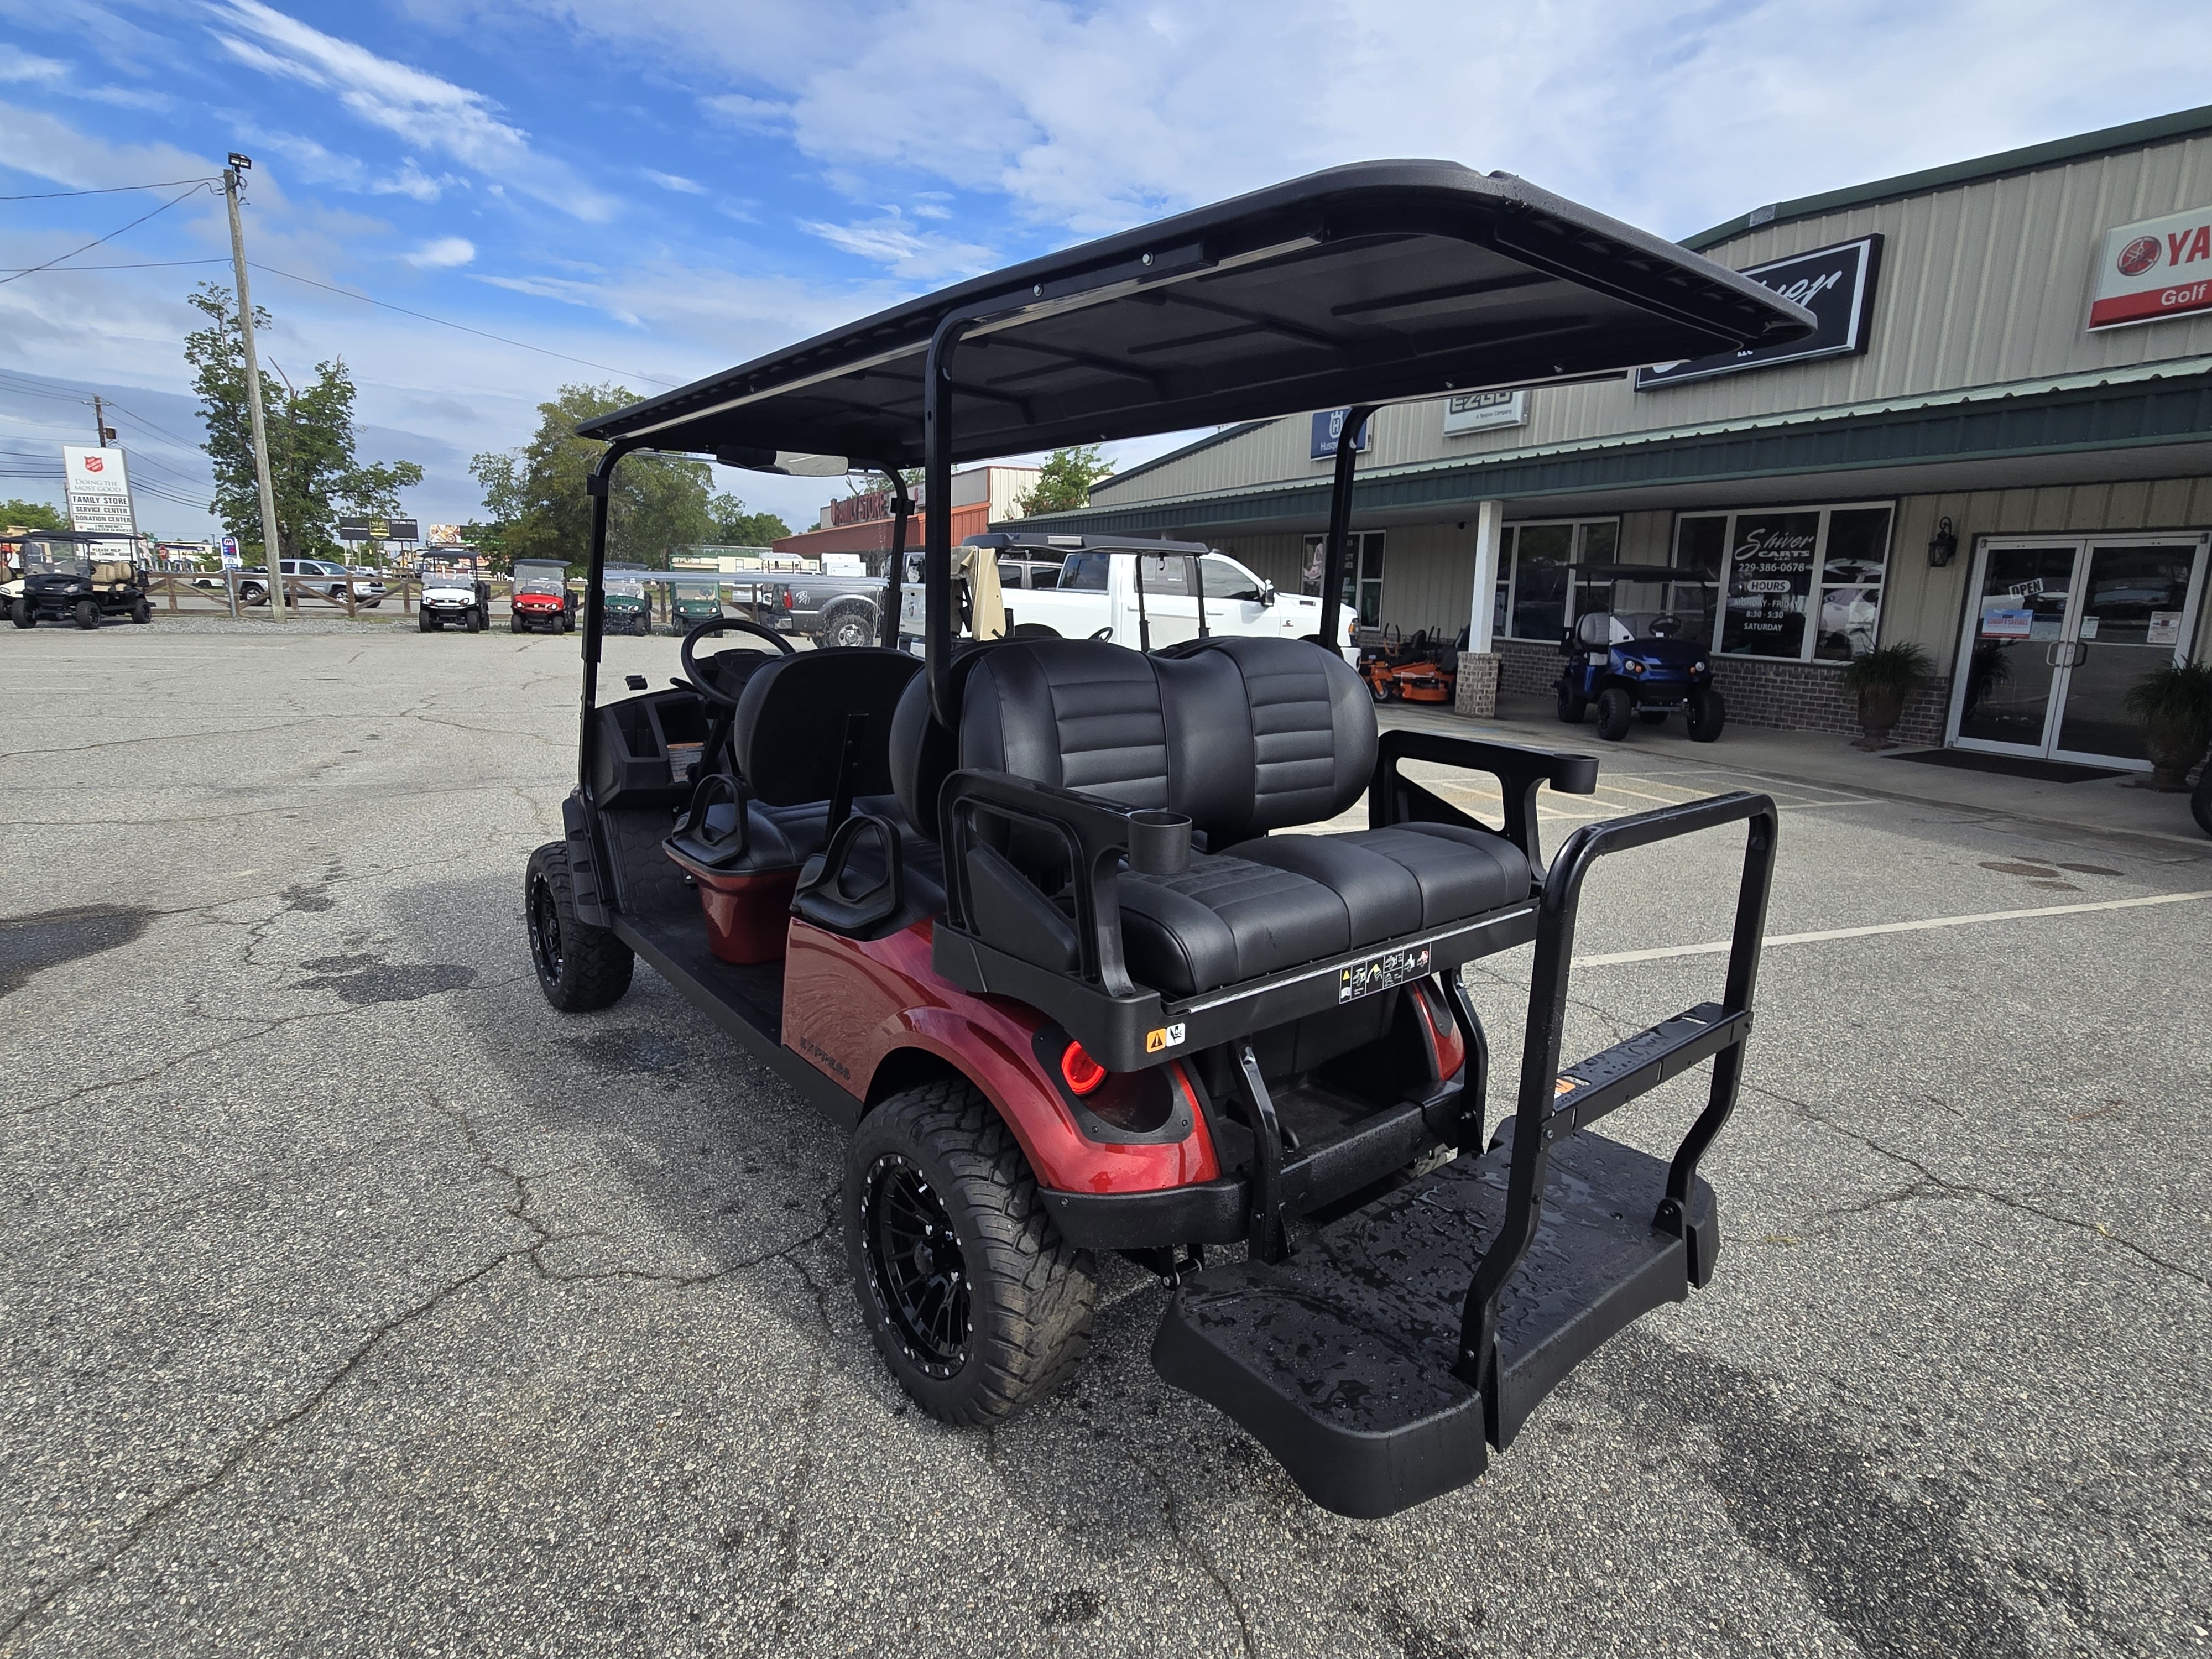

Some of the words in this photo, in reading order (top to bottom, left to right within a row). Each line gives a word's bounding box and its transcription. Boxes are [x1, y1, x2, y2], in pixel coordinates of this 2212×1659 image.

[2161, 284, 2208, 306] Golf
[73, 495, 100, 504] FAMILY
[858, 490, 885, 520] STORE
[1735, 528, 1814, 561] Shiver
[1738, 562, 1805, 572] 229-386-0678
[1751, 581, 1786, 591] HOURS
[2011, 580, 2041, 596] OPEN
[1734, 599, 1767, 607] MONDAY
[1772, 599, 1800, 608] FRIDAY
[1744, 622, 1783, 632] SATURDAY
